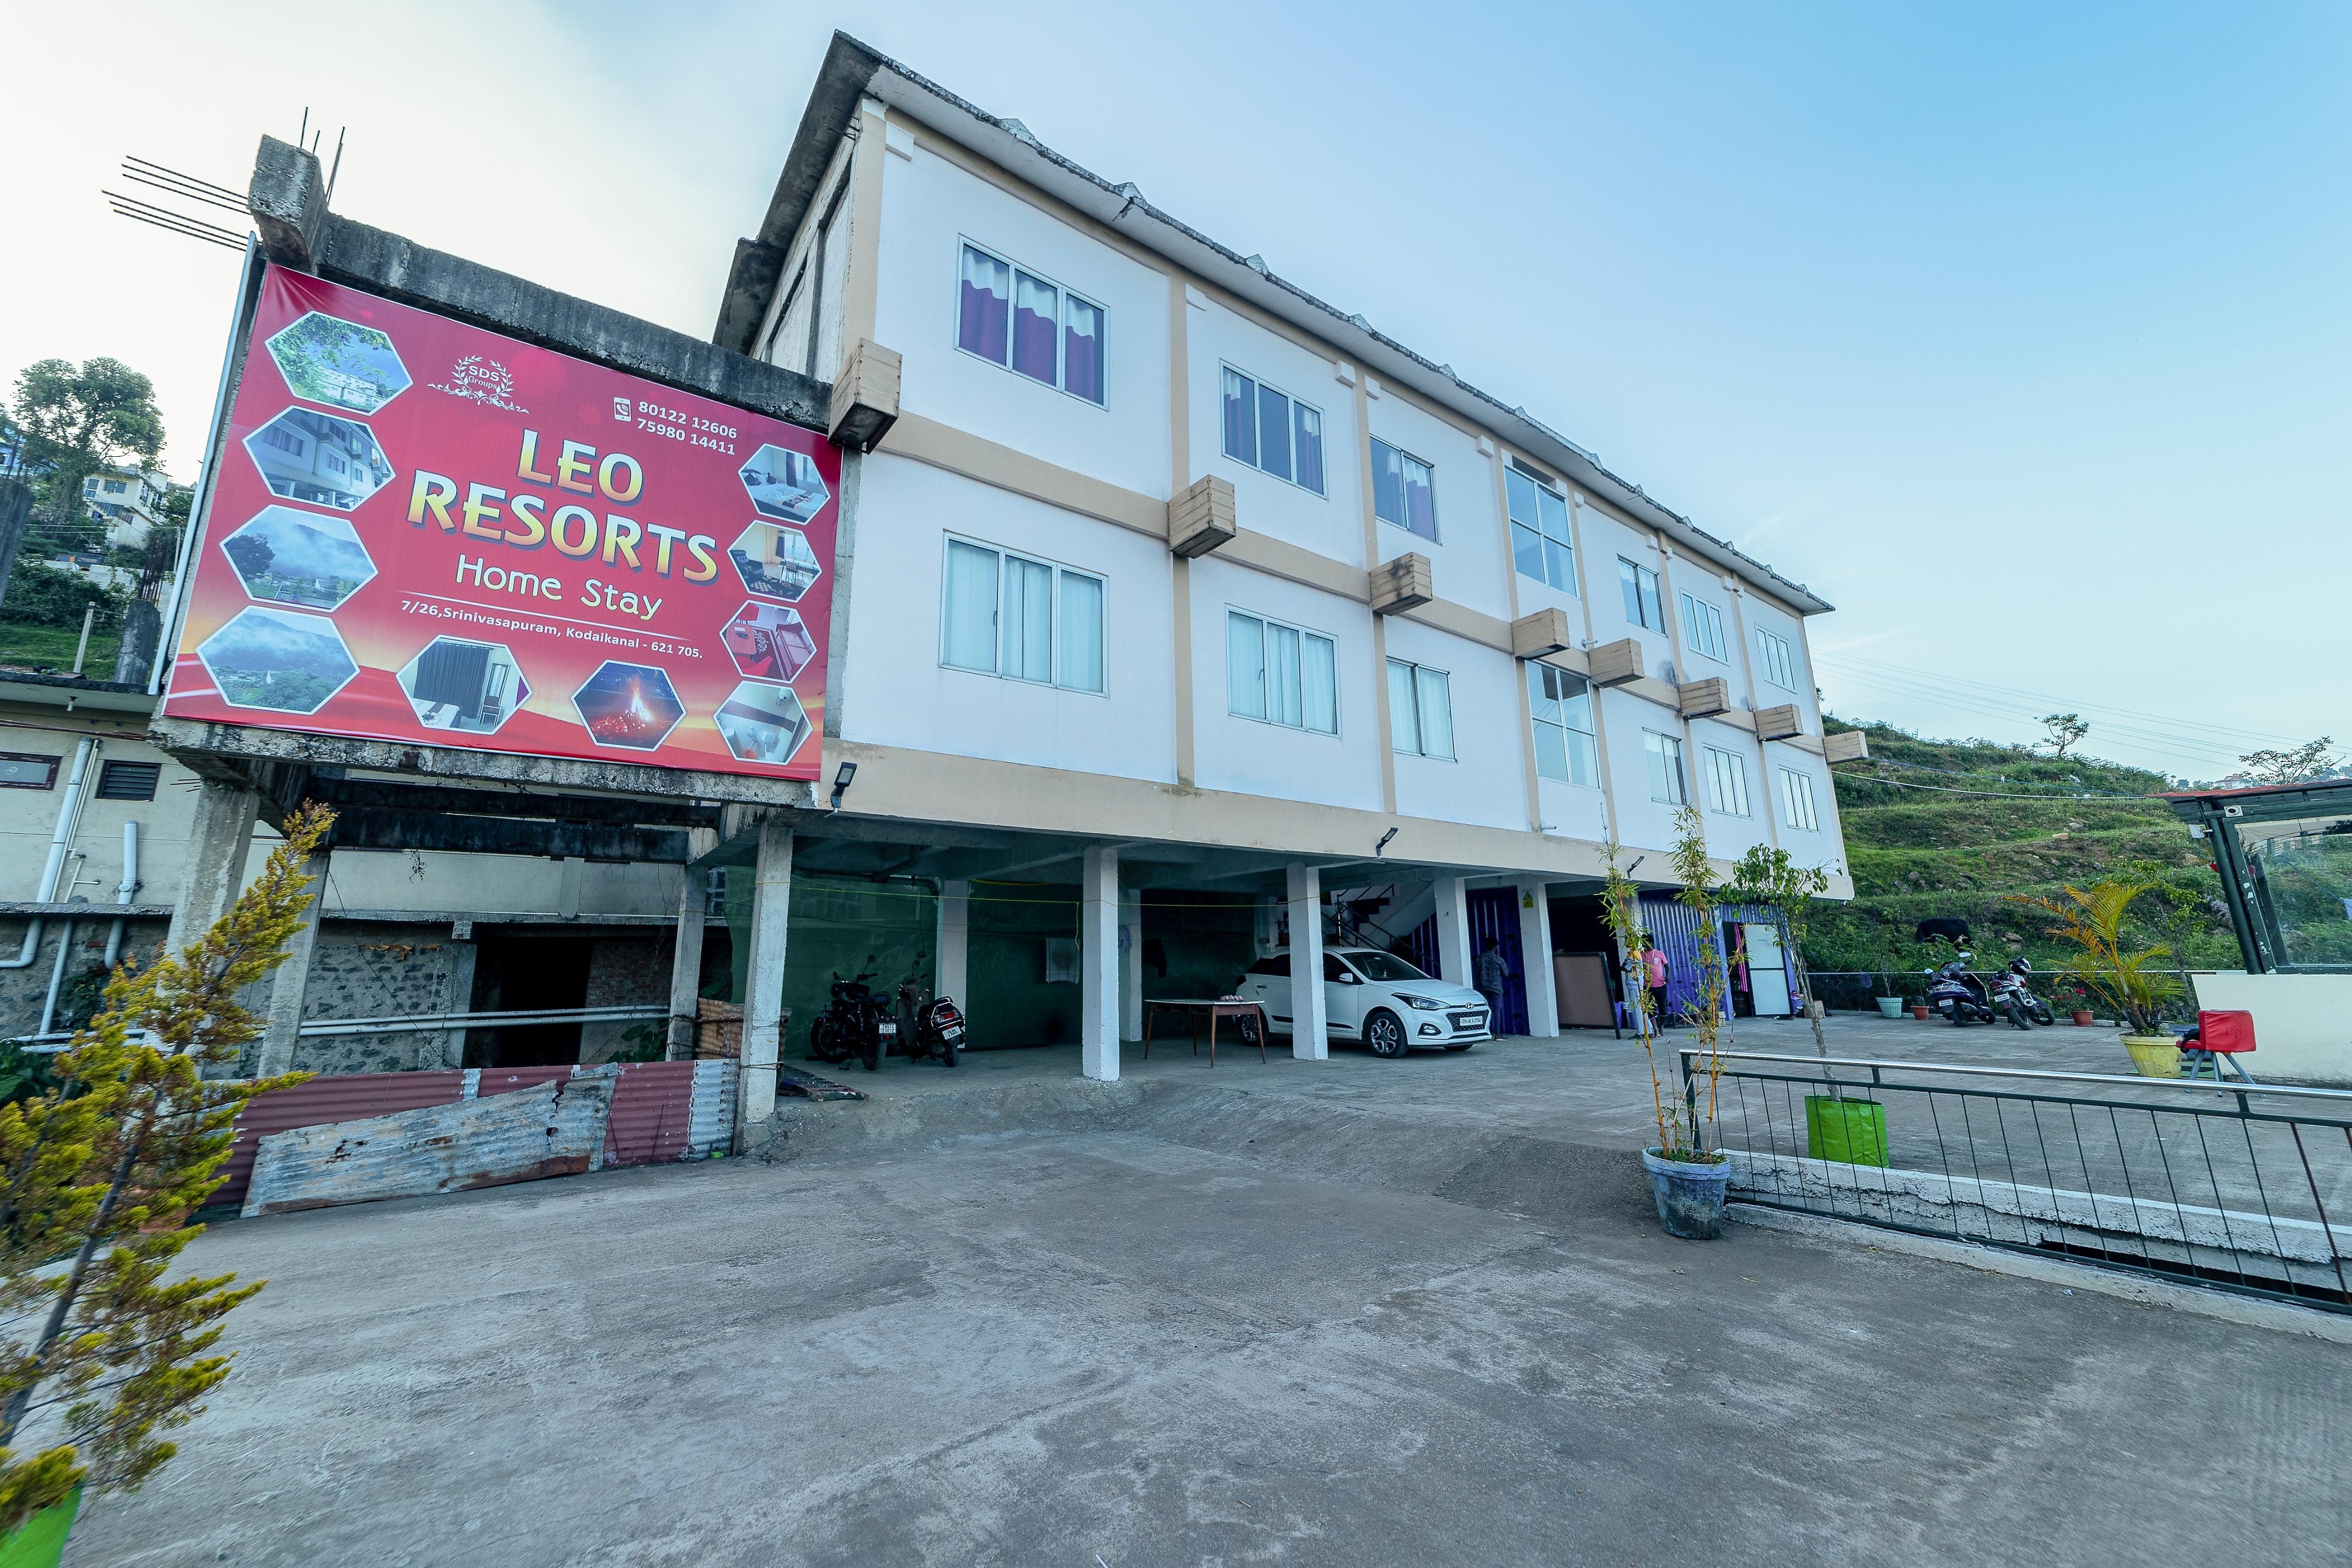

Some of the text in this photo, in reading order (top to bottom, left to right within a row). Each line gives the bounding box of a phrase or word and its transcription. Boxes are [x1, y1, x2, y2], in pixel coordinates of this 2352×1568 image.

[468, 365, 500, 382] SDS
[468, 376, 497, 389] Groups
[637, 418, 736, 455] 75980 14411
[638, 401, 737, 439] 80122 12606
[516, 428, 644, 504] LEO
[406, 469, 719, 584] RESORTS
[455, 554, 663, 621] Home Stay
[401, 600, 561, 637] 7/26,Srinivasapuram,
[566, 627, 640, 648] Kodaikanal
[651, 642, 673, 654] 621
[677, 646, 703, 658] 705.
